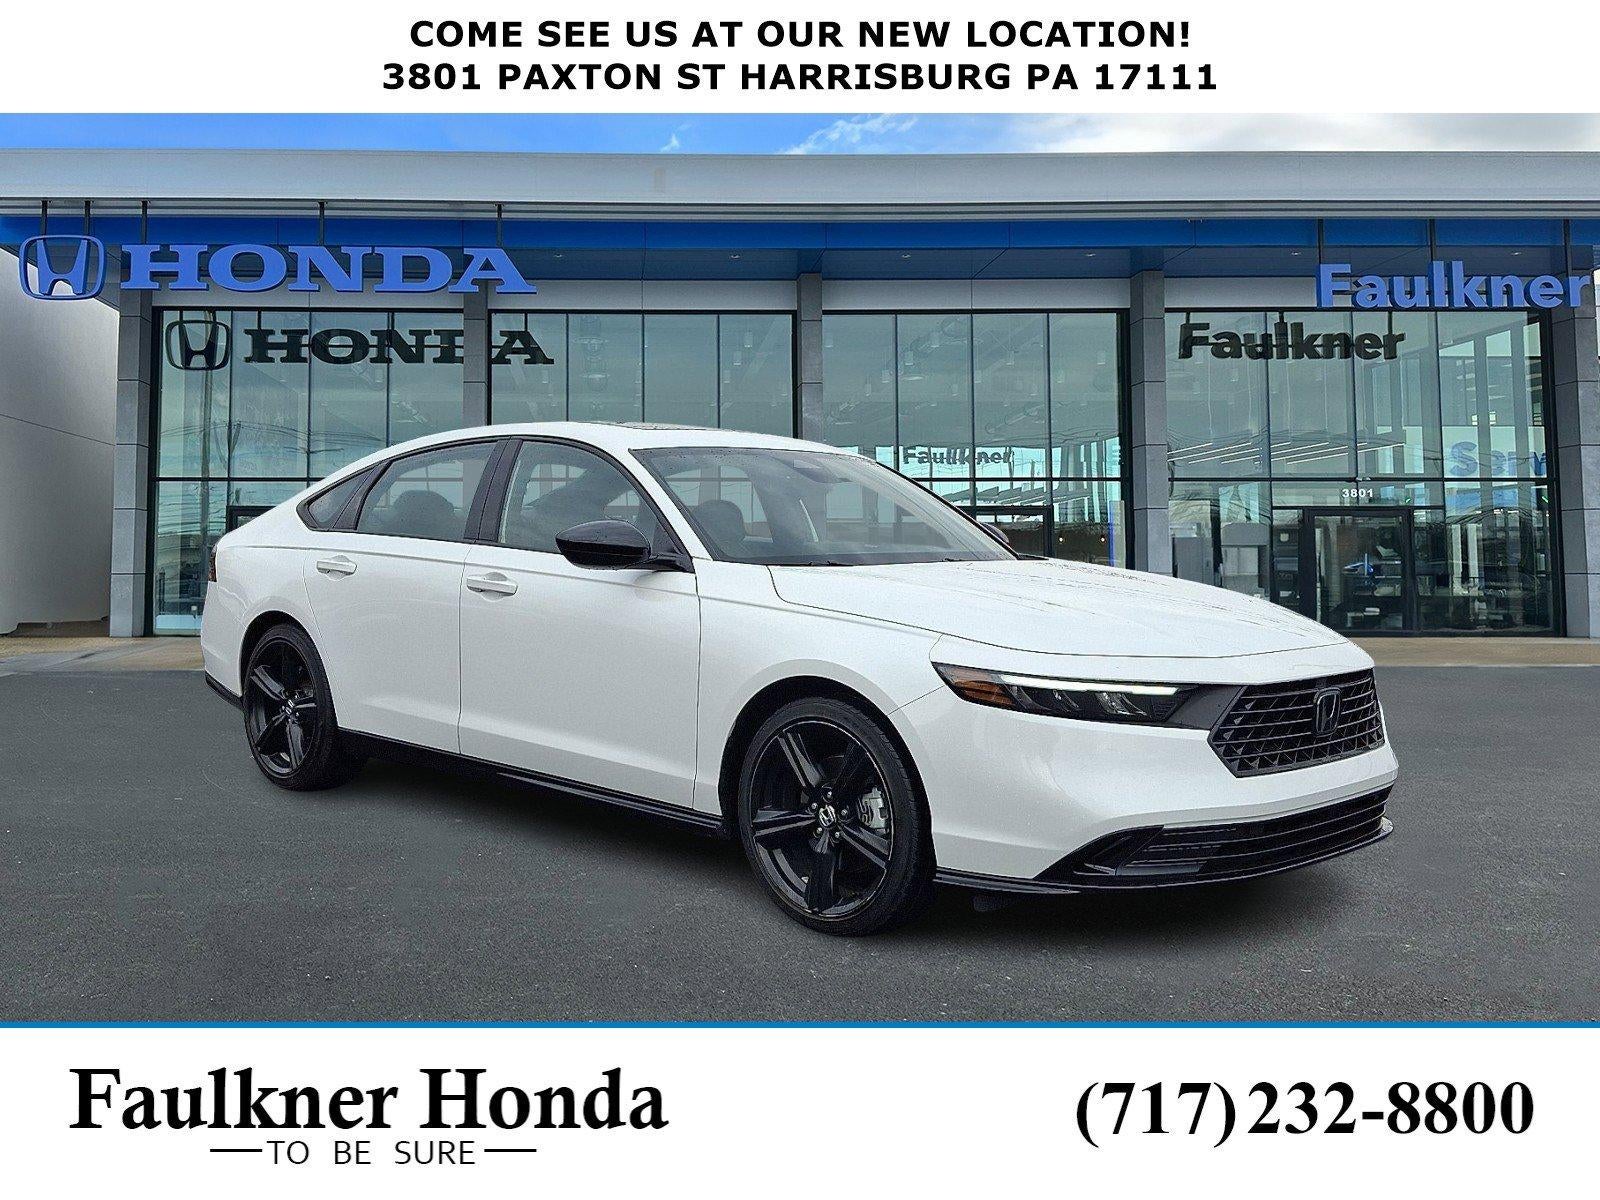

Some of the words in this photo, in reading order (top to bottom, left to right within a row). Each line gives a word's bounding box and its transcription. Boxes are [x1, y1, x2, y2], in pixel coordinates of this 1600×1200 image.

[121, 243, 538, 294] HONDA
[1316, 260, 1592, 309] Faulkner
[1178, 321, 1406, 360] Faulkner
[1342, 488, 1373, 498] 3801
